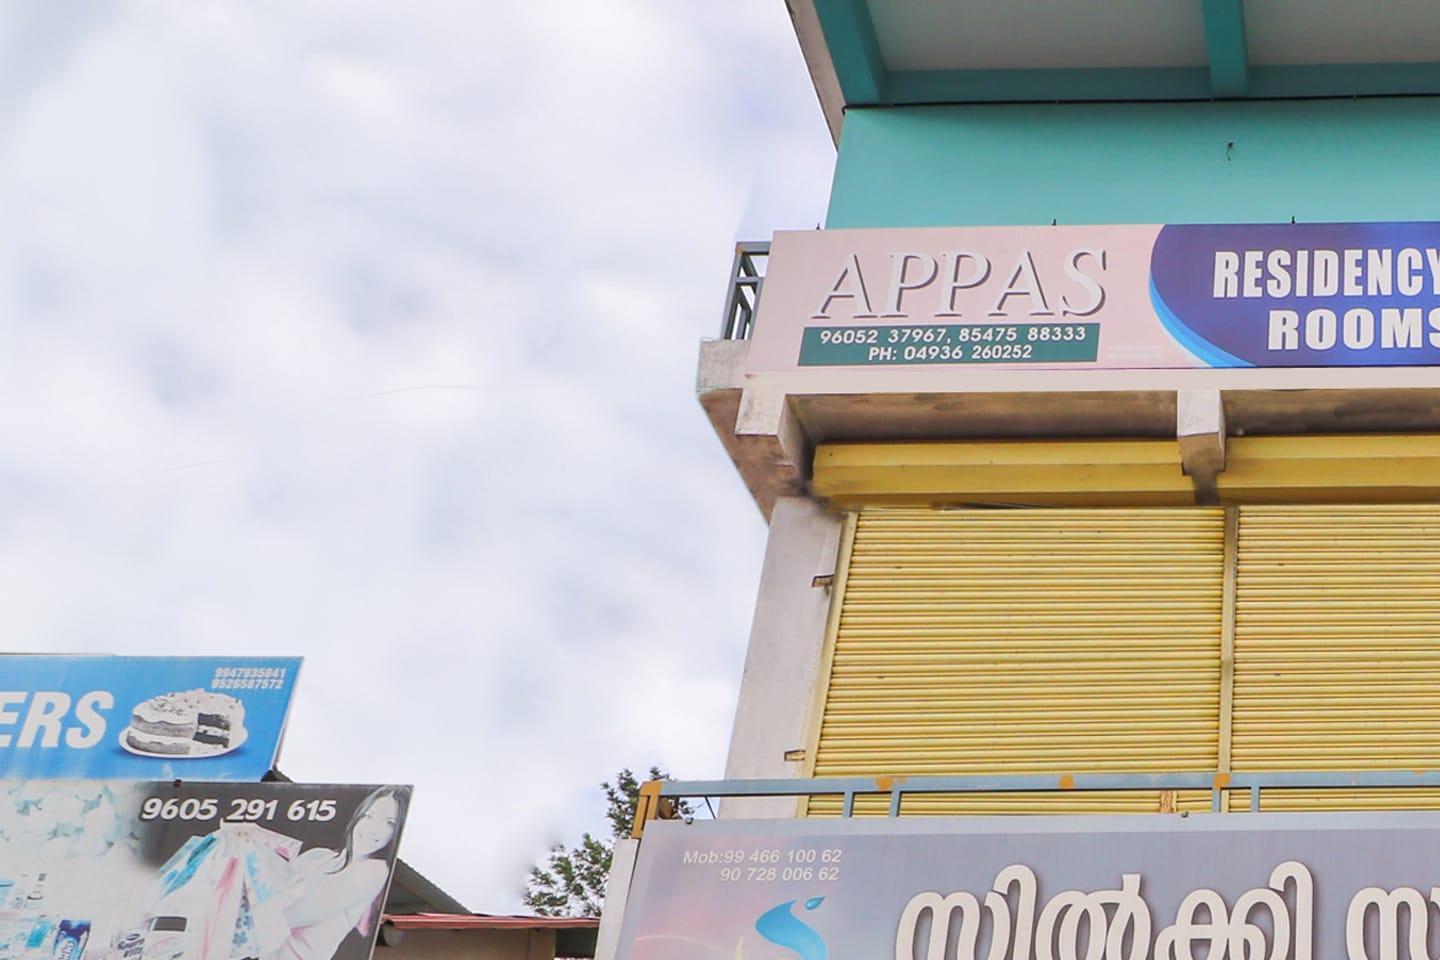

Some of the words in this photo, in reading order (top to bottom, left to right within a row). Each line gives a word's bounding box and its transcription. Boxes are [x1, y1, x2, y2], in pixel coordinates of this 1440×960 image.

[810, 247, 1107, 320] APPAS
[820, 327, 878, 344] 96052
[887, 327, 952, 345] 37967,
[958, 326, 1018, 343] 85475
[1027, 326, 1086, 342] 88333
[867, 347, 897, 362] PH:
[903, 345, 963, 362] 04936
[970, 344, 1033, 361] 260252
[140, 797, 218, 822] 9605
[226, 798, 277, 821] 291
[287, 799, 337, 822] 615
[749, 848, 780, 864] 466
[785, 848, 817, 863] 100
[821, 848, 842, 863] 62
[720, 867, 742, 882] 90
[745, 866, 777, 882] 728
[781, 866, 813, 881] 006
[817, 866, 840, 881] 62
